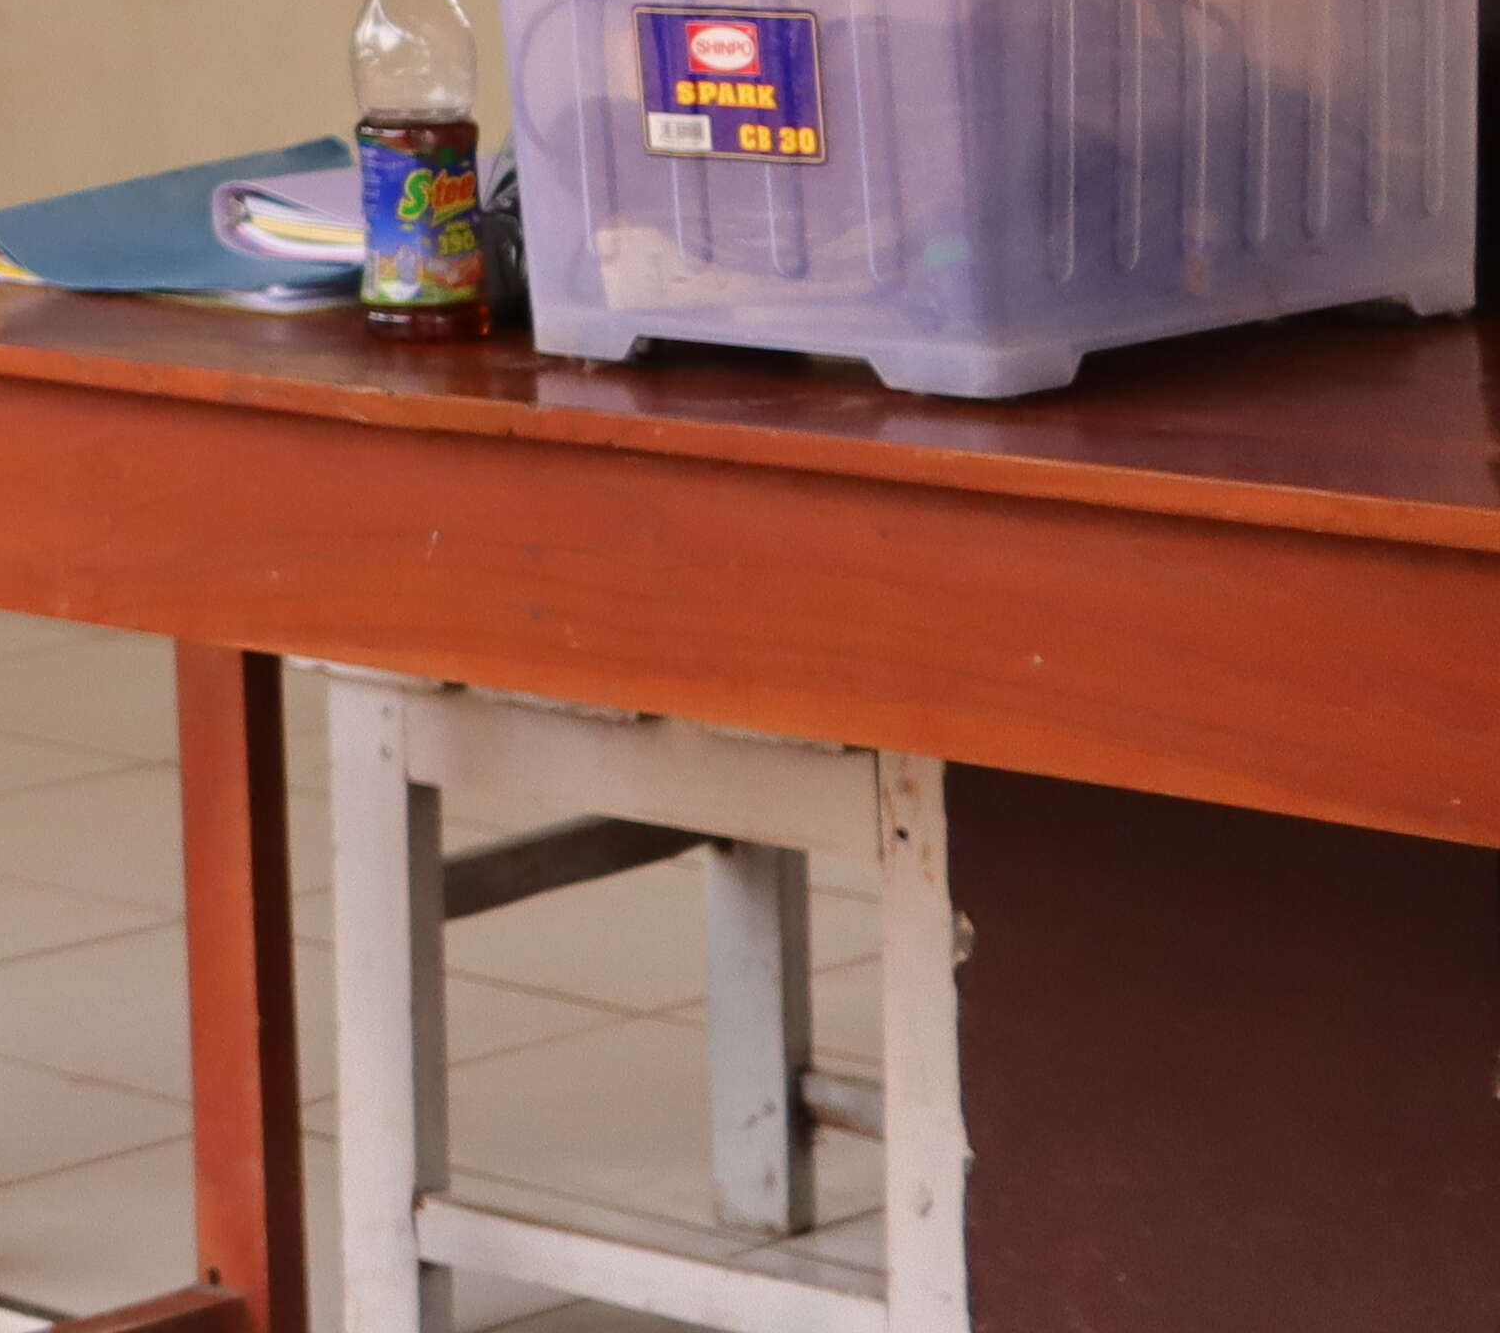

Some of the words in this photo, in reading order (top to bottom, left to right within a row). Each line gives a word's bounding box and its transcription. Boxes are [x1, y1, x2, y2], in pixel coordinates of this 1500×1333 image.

[695, 39, 751, 56] SHINPO
[675, 80, 778, 110] SPARK
[739, 123, 773, 152] CB
[778, 127, 818, 155] 30
